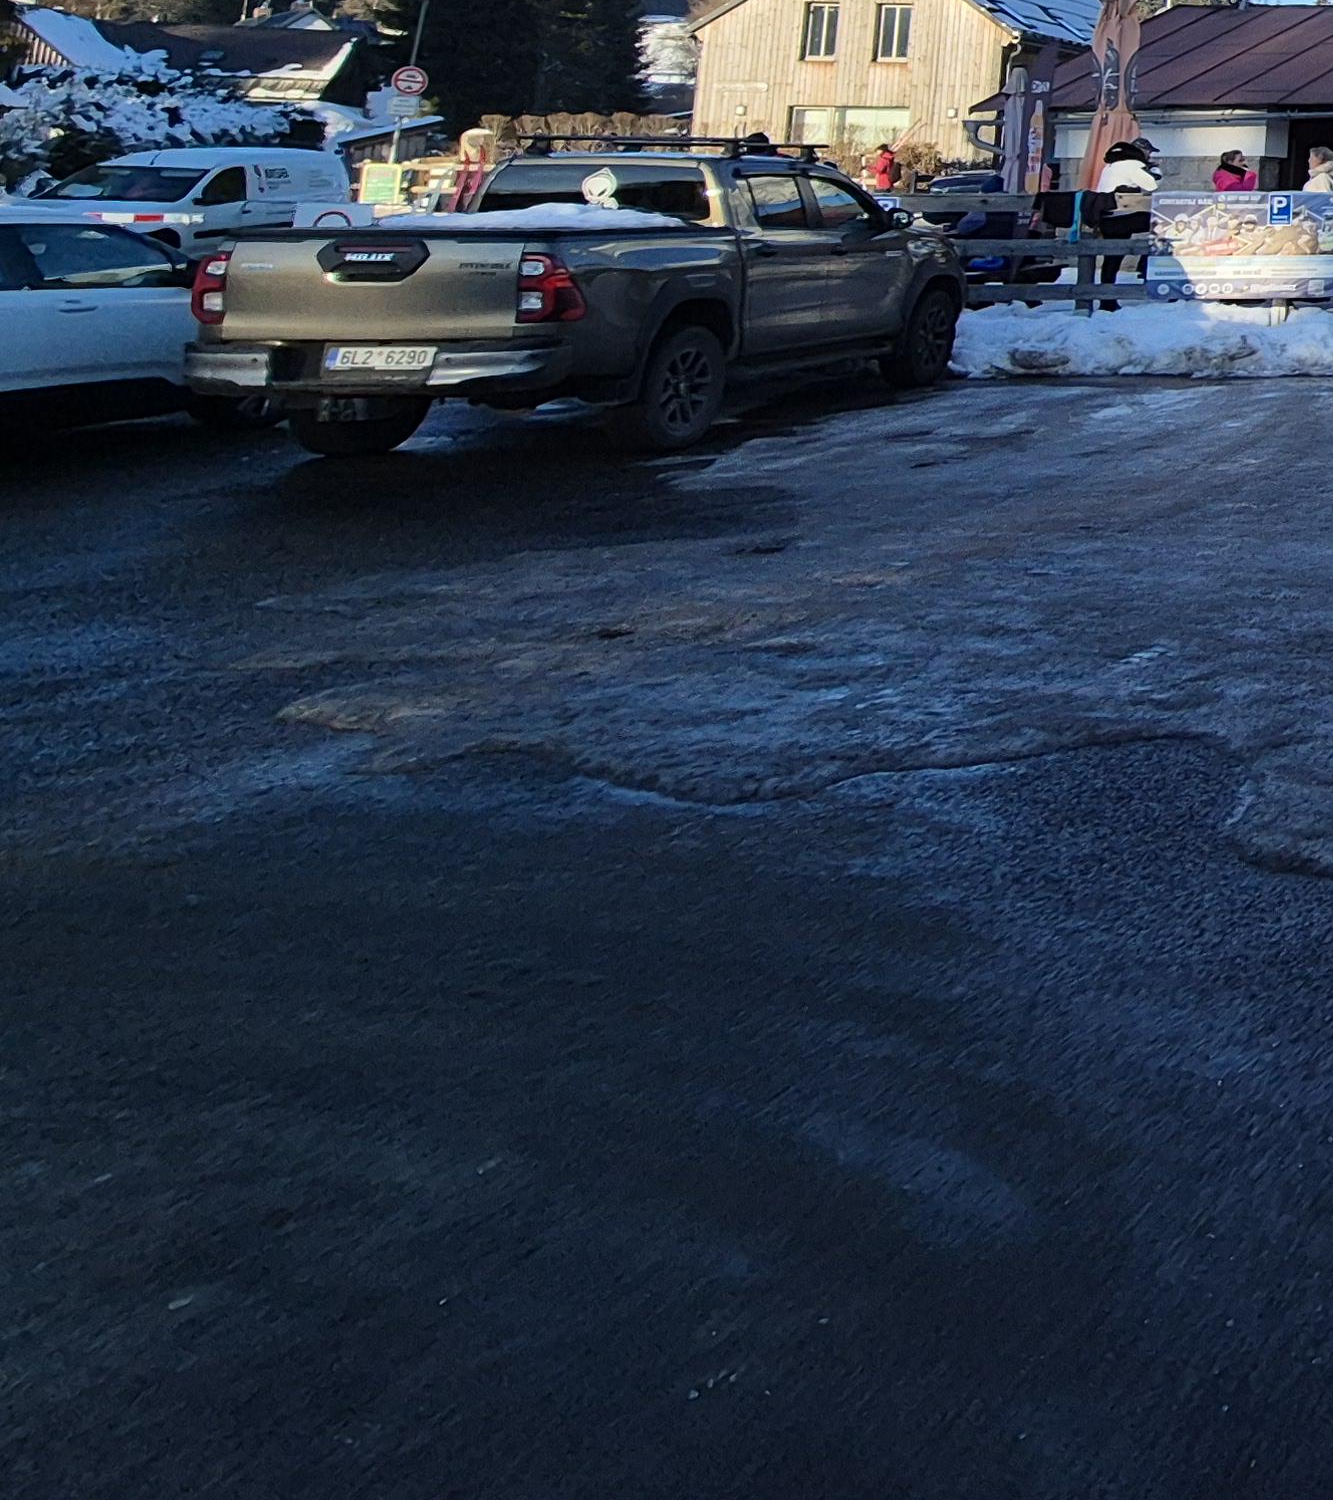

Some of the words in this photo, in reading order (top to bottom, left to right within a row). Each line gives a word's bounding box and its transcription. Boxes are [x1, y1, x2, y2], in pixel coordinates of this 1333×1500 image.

[1272, 197, 1288, 214] P
[340, 350, 372, 366] 6L2
[384, 349, 428, 365] 6290
